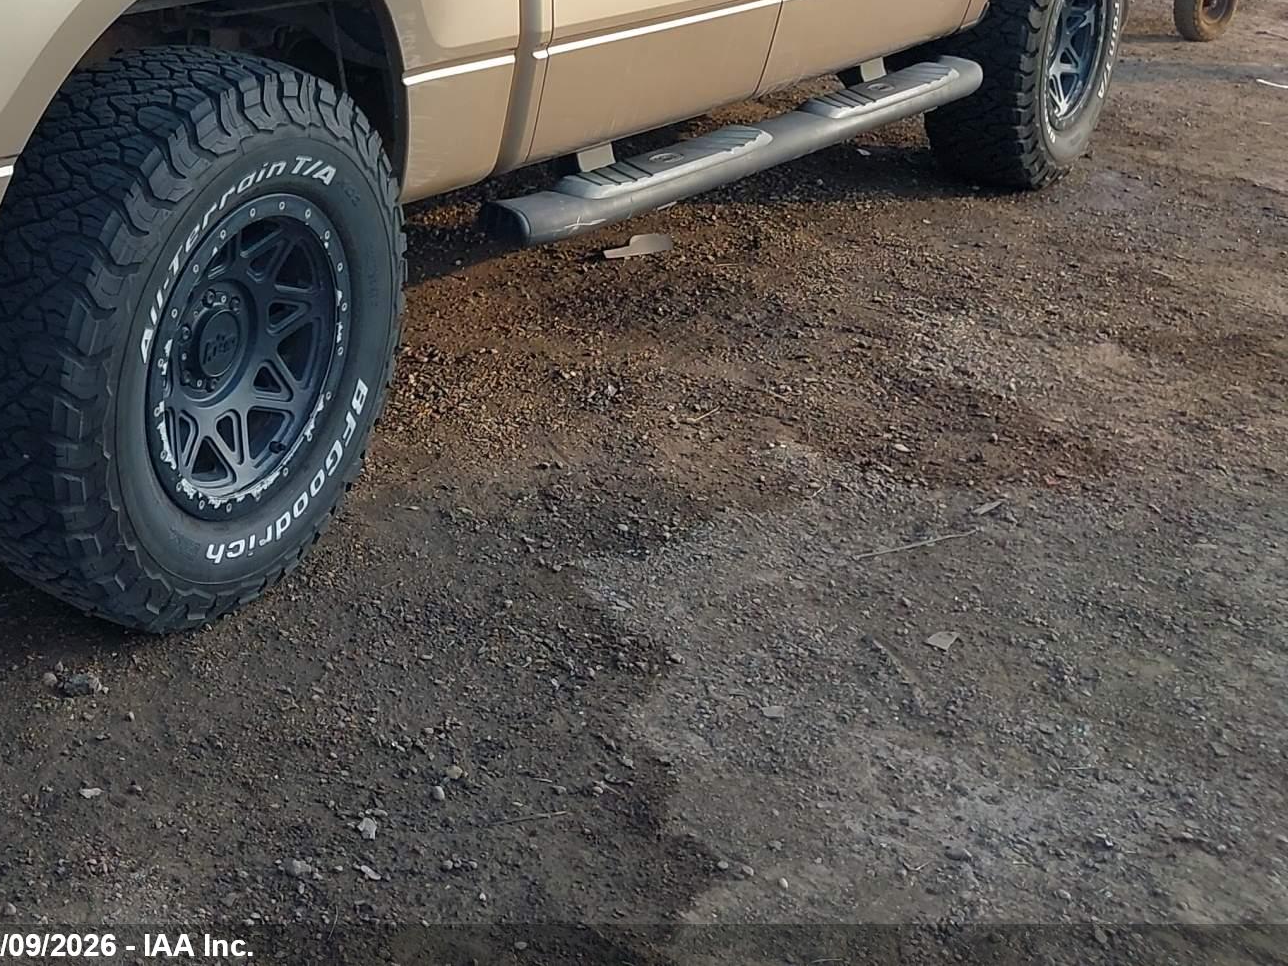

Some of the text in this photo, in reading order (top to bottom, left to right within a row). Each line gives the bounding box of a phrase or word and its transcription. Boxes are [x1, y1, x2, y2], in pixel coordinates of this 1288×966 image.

[140, 160, 287, 364] All-Terrain
[291, 155, 337, 186] T/A
[205, 377, 369, 564] BFGoodrich
